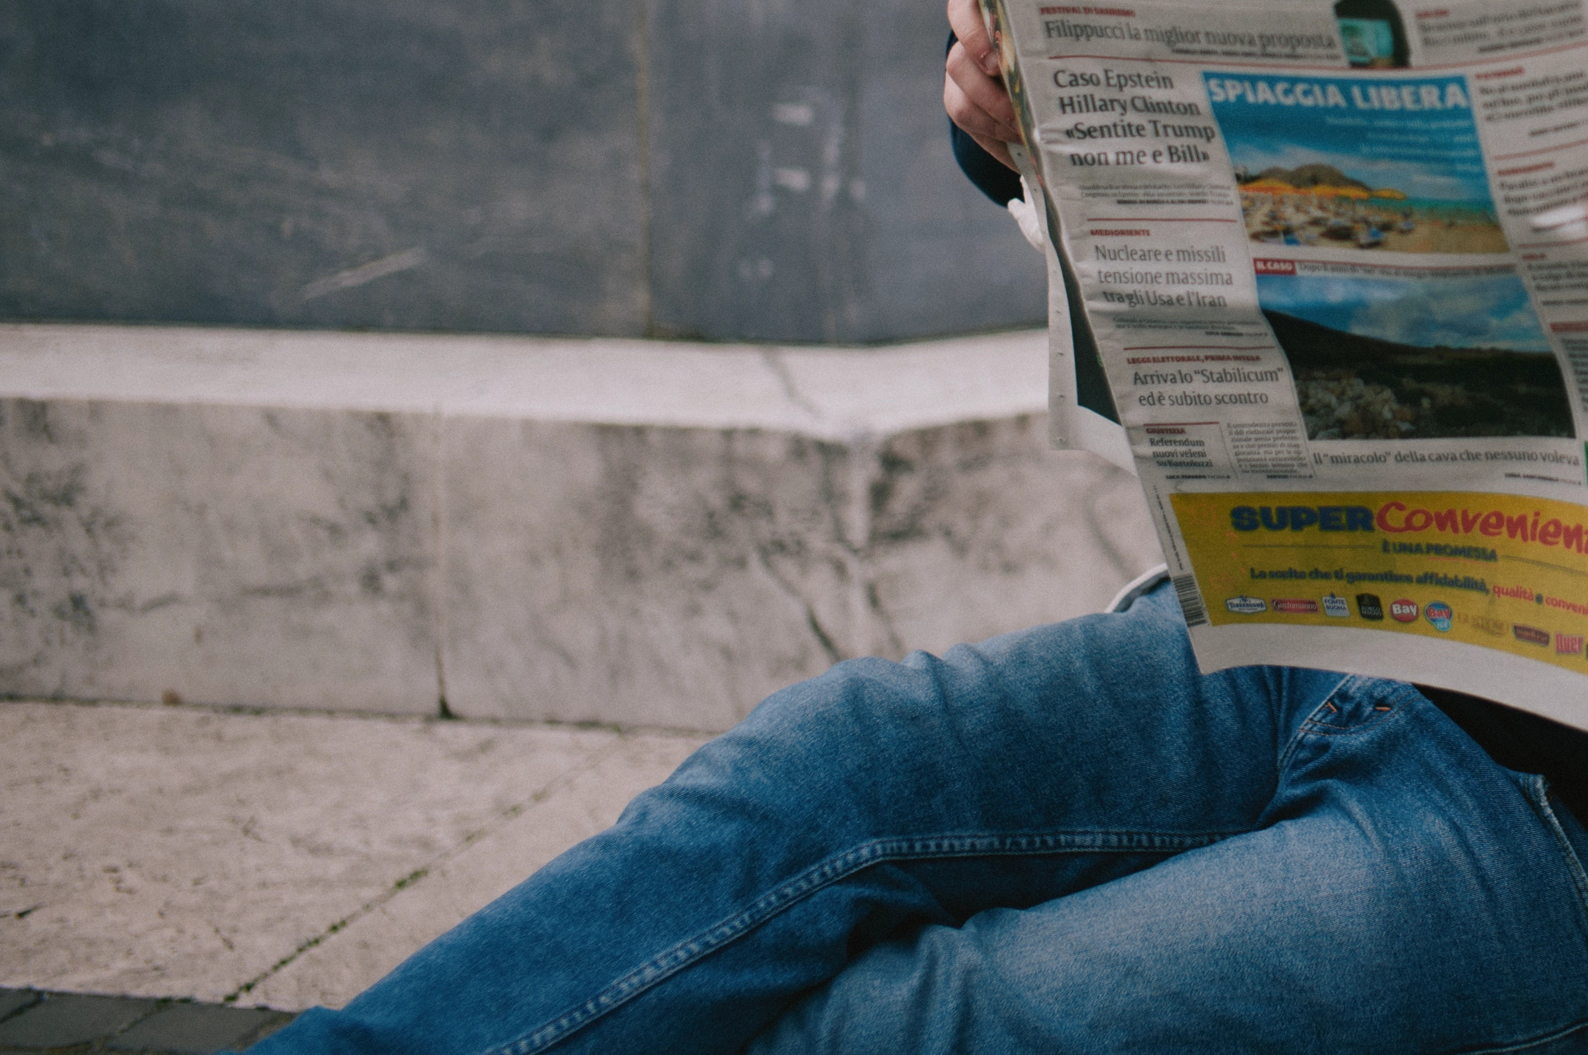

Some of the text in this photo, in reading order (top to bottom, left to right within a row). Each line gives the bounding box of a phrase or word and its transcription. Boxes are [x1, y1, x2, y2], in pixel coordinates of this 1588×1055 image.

[1044, 19, 1125, 42] Filippucci
[1126, 22, 1142, 41] la
[1144, 26, 1201, 48] miglior
[1204, 31, 1256, 45] nuova
[1257, 33, 1337, 54] proposta
[1053, 68, 1174, 92] Caso Epstein
[1207, 78, 1348, 109] SPIAGGIA
[1353, 82, 1471, 111] LIBERA
[1059, 94, 1201, 116] Hillary Clinton
[1066, 119, 1215, 143] «Sentite Trump
[1070, 145, 1210, 166] non me e Bill»
[1090, 229, 1151, 237] MEDIORIENTE
[1095, 245, 1227, 263] Nucleare e missili
[1256, 262, 1293, 271] IL CASO
[1098, 268, 1233, 286] tensione massima
[1103, 291, 1125, 304] tra
[1126, 291, 1146, 309] gli
[1147, 291, 1173, 306] Usa
[1173, 294, 1186, 306] e
[1127, 354, 1262, 364] LEGGE ELETTORALE, PRIMA INTESA
[1134, 368, 1284, 385] Arriva lo “Stabilicum”
[1139, 390, 1268, 406] ed è subito scontro
[1146, 427, 1187, 435] GIUSTIZIA
[1149, 437, 1205, 447] Referendum
[1152, 448, 1207, 458] nuovi veleni
[1313, 453, 1323, 464] Il
[1324, 451, 1391, 464] “miracolo”
[1394, 450, 1426, 463] della
[1427, 452, 1456, 463] cava
[1458, 450, 1482, 462] che
[1483, 449, 1539, 462] nessuno
[1540, 449, 1580, 466] voleva
[1165, 459, 1214, 467] Bartolozzi
[1230, 504, 1376, 533] SUPER
[1381, 539, 1498, 562] È UNA PROMESSA
[1250, 567, 1266, 580] La
[1268, 567, 1307, 580] scelta
[1308, 567, 1332, 580] che
[1333, 567, 1344, 580] ti
[1346, 570, 1414, 585] garantisce
[1416, 571, 1490, 596] affidabilità,
[1492, 583, 1535, 602] qualità
[1535, 593, 1543, 604] e
[1324, 598, 1345, 606] FONTE
[1392, 603, 1417, 617] Bay
[1426, 607, 1451, 620] Bay
